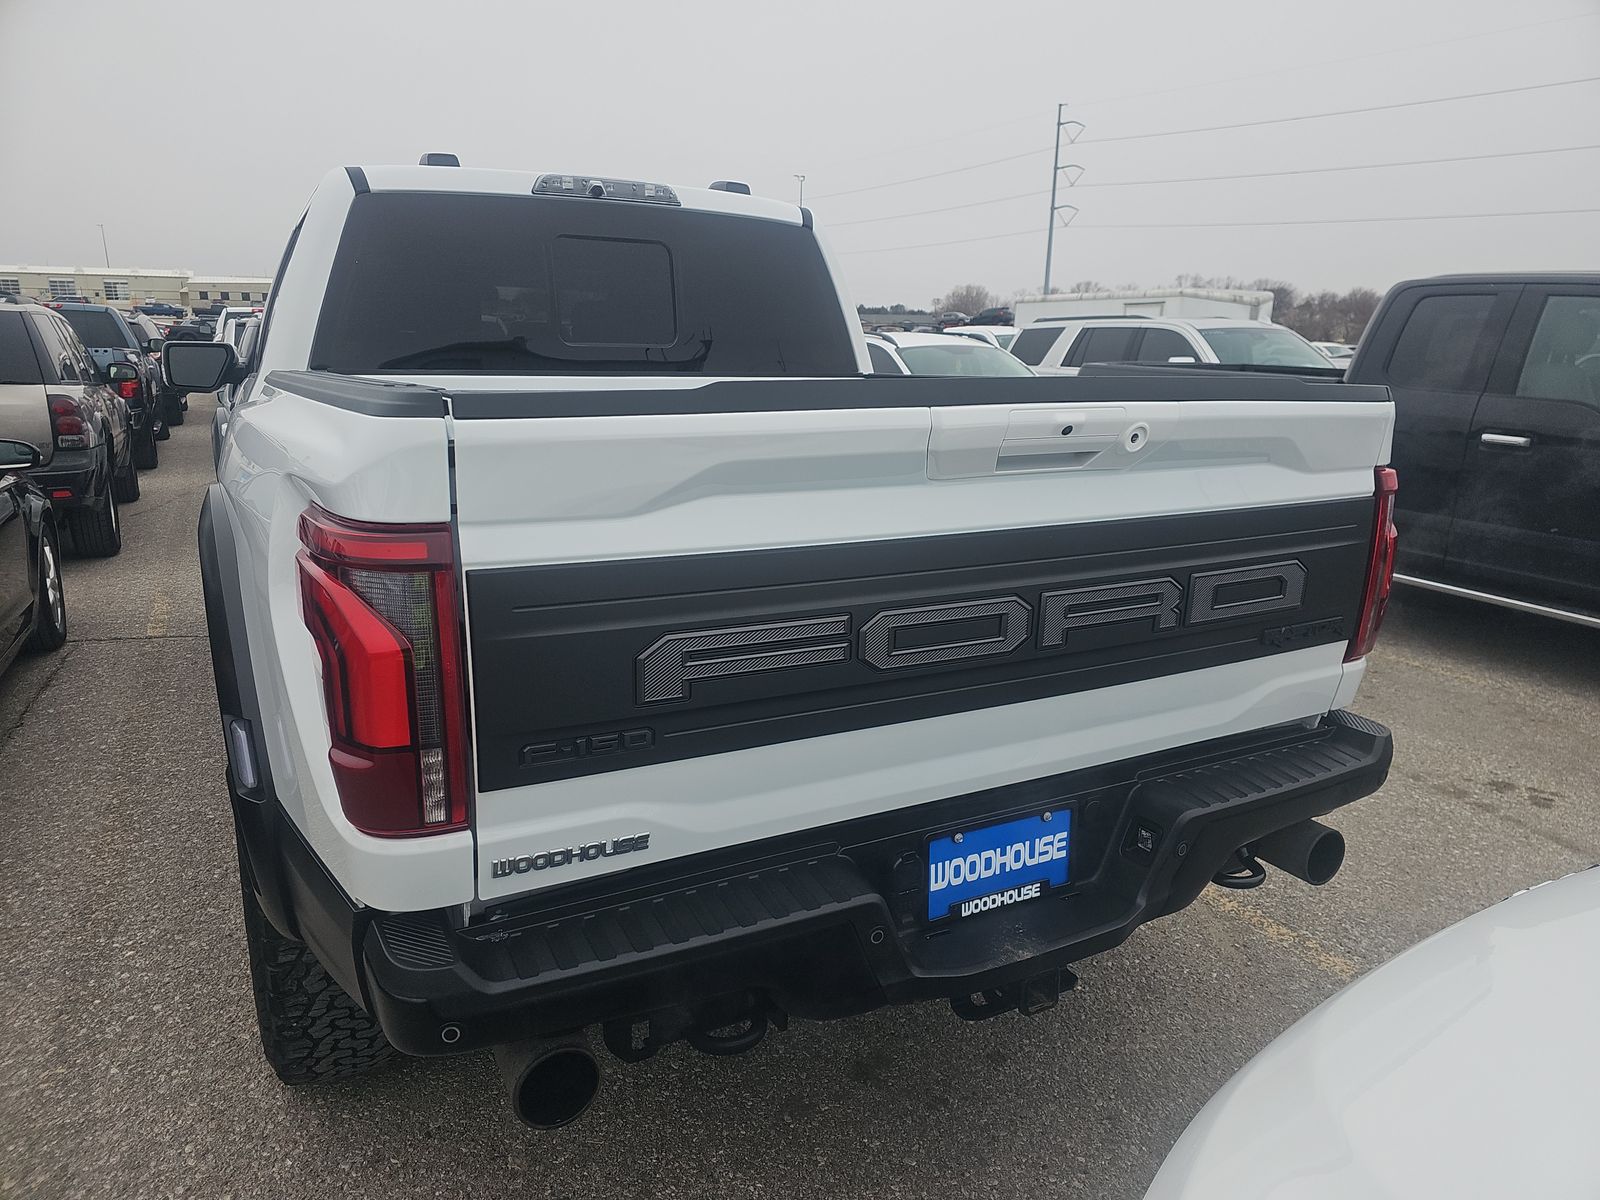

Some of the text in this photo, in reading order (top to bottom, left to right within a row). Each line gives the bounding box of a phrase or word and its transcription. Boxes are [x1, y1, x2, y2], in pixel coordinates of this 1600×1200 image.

[637, 559, 1307, 705] FORD
[519, 726, 655, 767] F-150
[492, 832, 650, 879] WOODHOUSE
[930, 832, 1068, 892] WOODHOUSE
[961, 883, 1041, 917] WOODHOUSE
